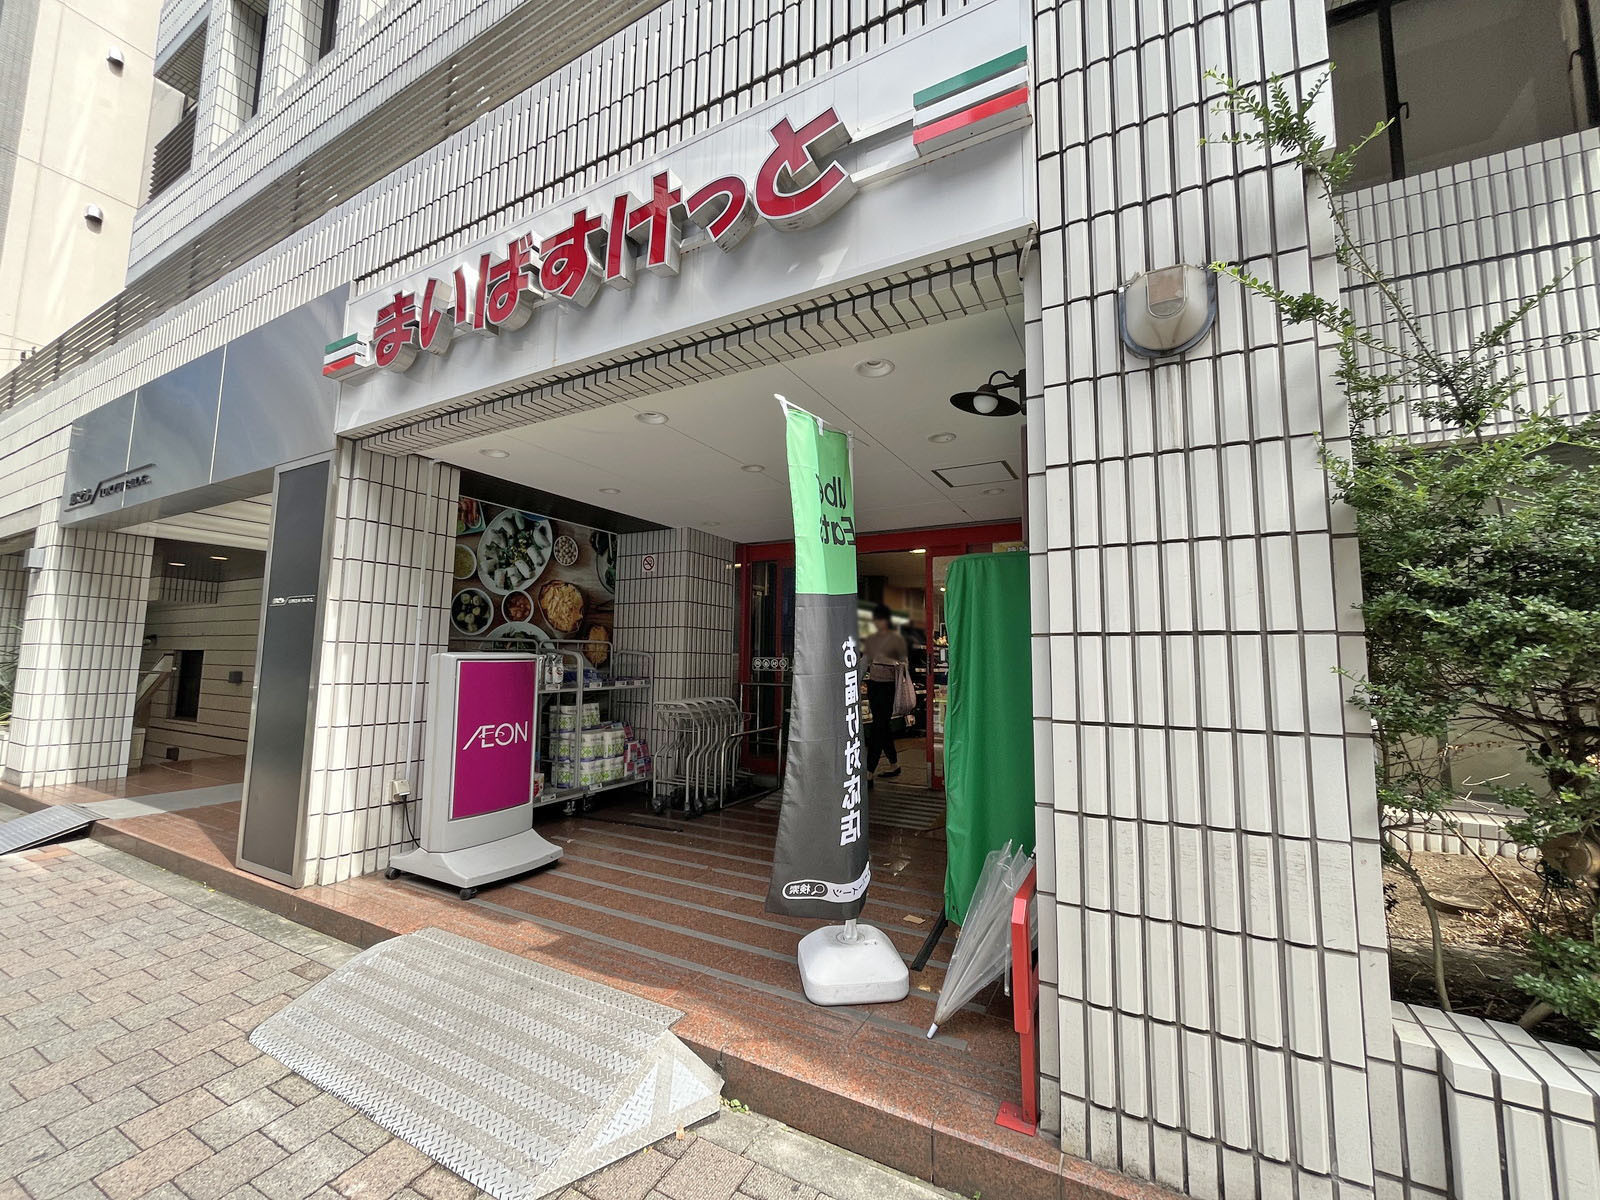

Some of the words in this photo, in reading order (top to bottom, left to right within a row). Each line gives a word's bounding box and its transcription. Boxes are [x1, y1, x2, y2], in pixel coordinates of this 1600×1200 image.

[373, 106, 849, 367] まいばすけっと
